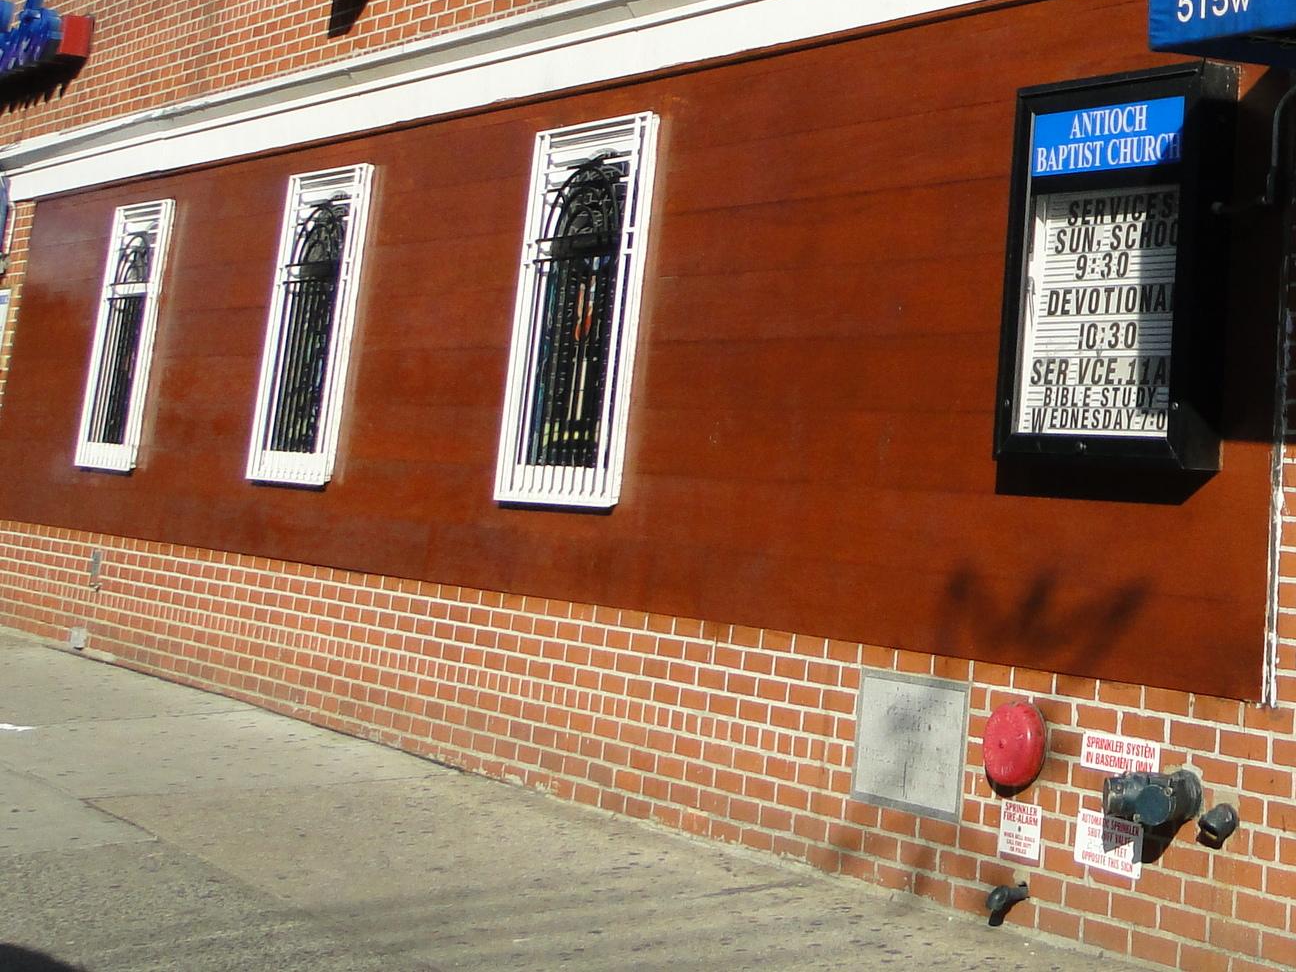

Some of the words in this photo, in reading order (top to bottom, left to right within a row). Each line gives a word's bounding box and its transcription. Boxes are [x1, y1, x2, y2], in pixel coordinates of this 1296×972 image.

[1069, 104, 1148, 139] ANTIOCH
[1036, 140, 1104, 173] BAPTIST
[1107, 132, 1182, 166] CHURCH
[1067, 191, 1174, 227] SERVICES
[1075, 251, 1130, 280] 9:30
[1078, 321, 1137, 350] 10:30
[1043, 386, 1092, 408] BIBLE
[1100, 386, 1157, 408] STUDY
[1031, 407, 1135, 433] WEDNESDAY
[1086, 735, 1125, 755] SPRINKLER
[1126, 742, 1155, 760] SYSTEM
[1085, 751, 1094, 765] IN
[1095, 752, 1134, 773] BASEMENT
[1005, 801, 1038, 817] SPRINKLER
